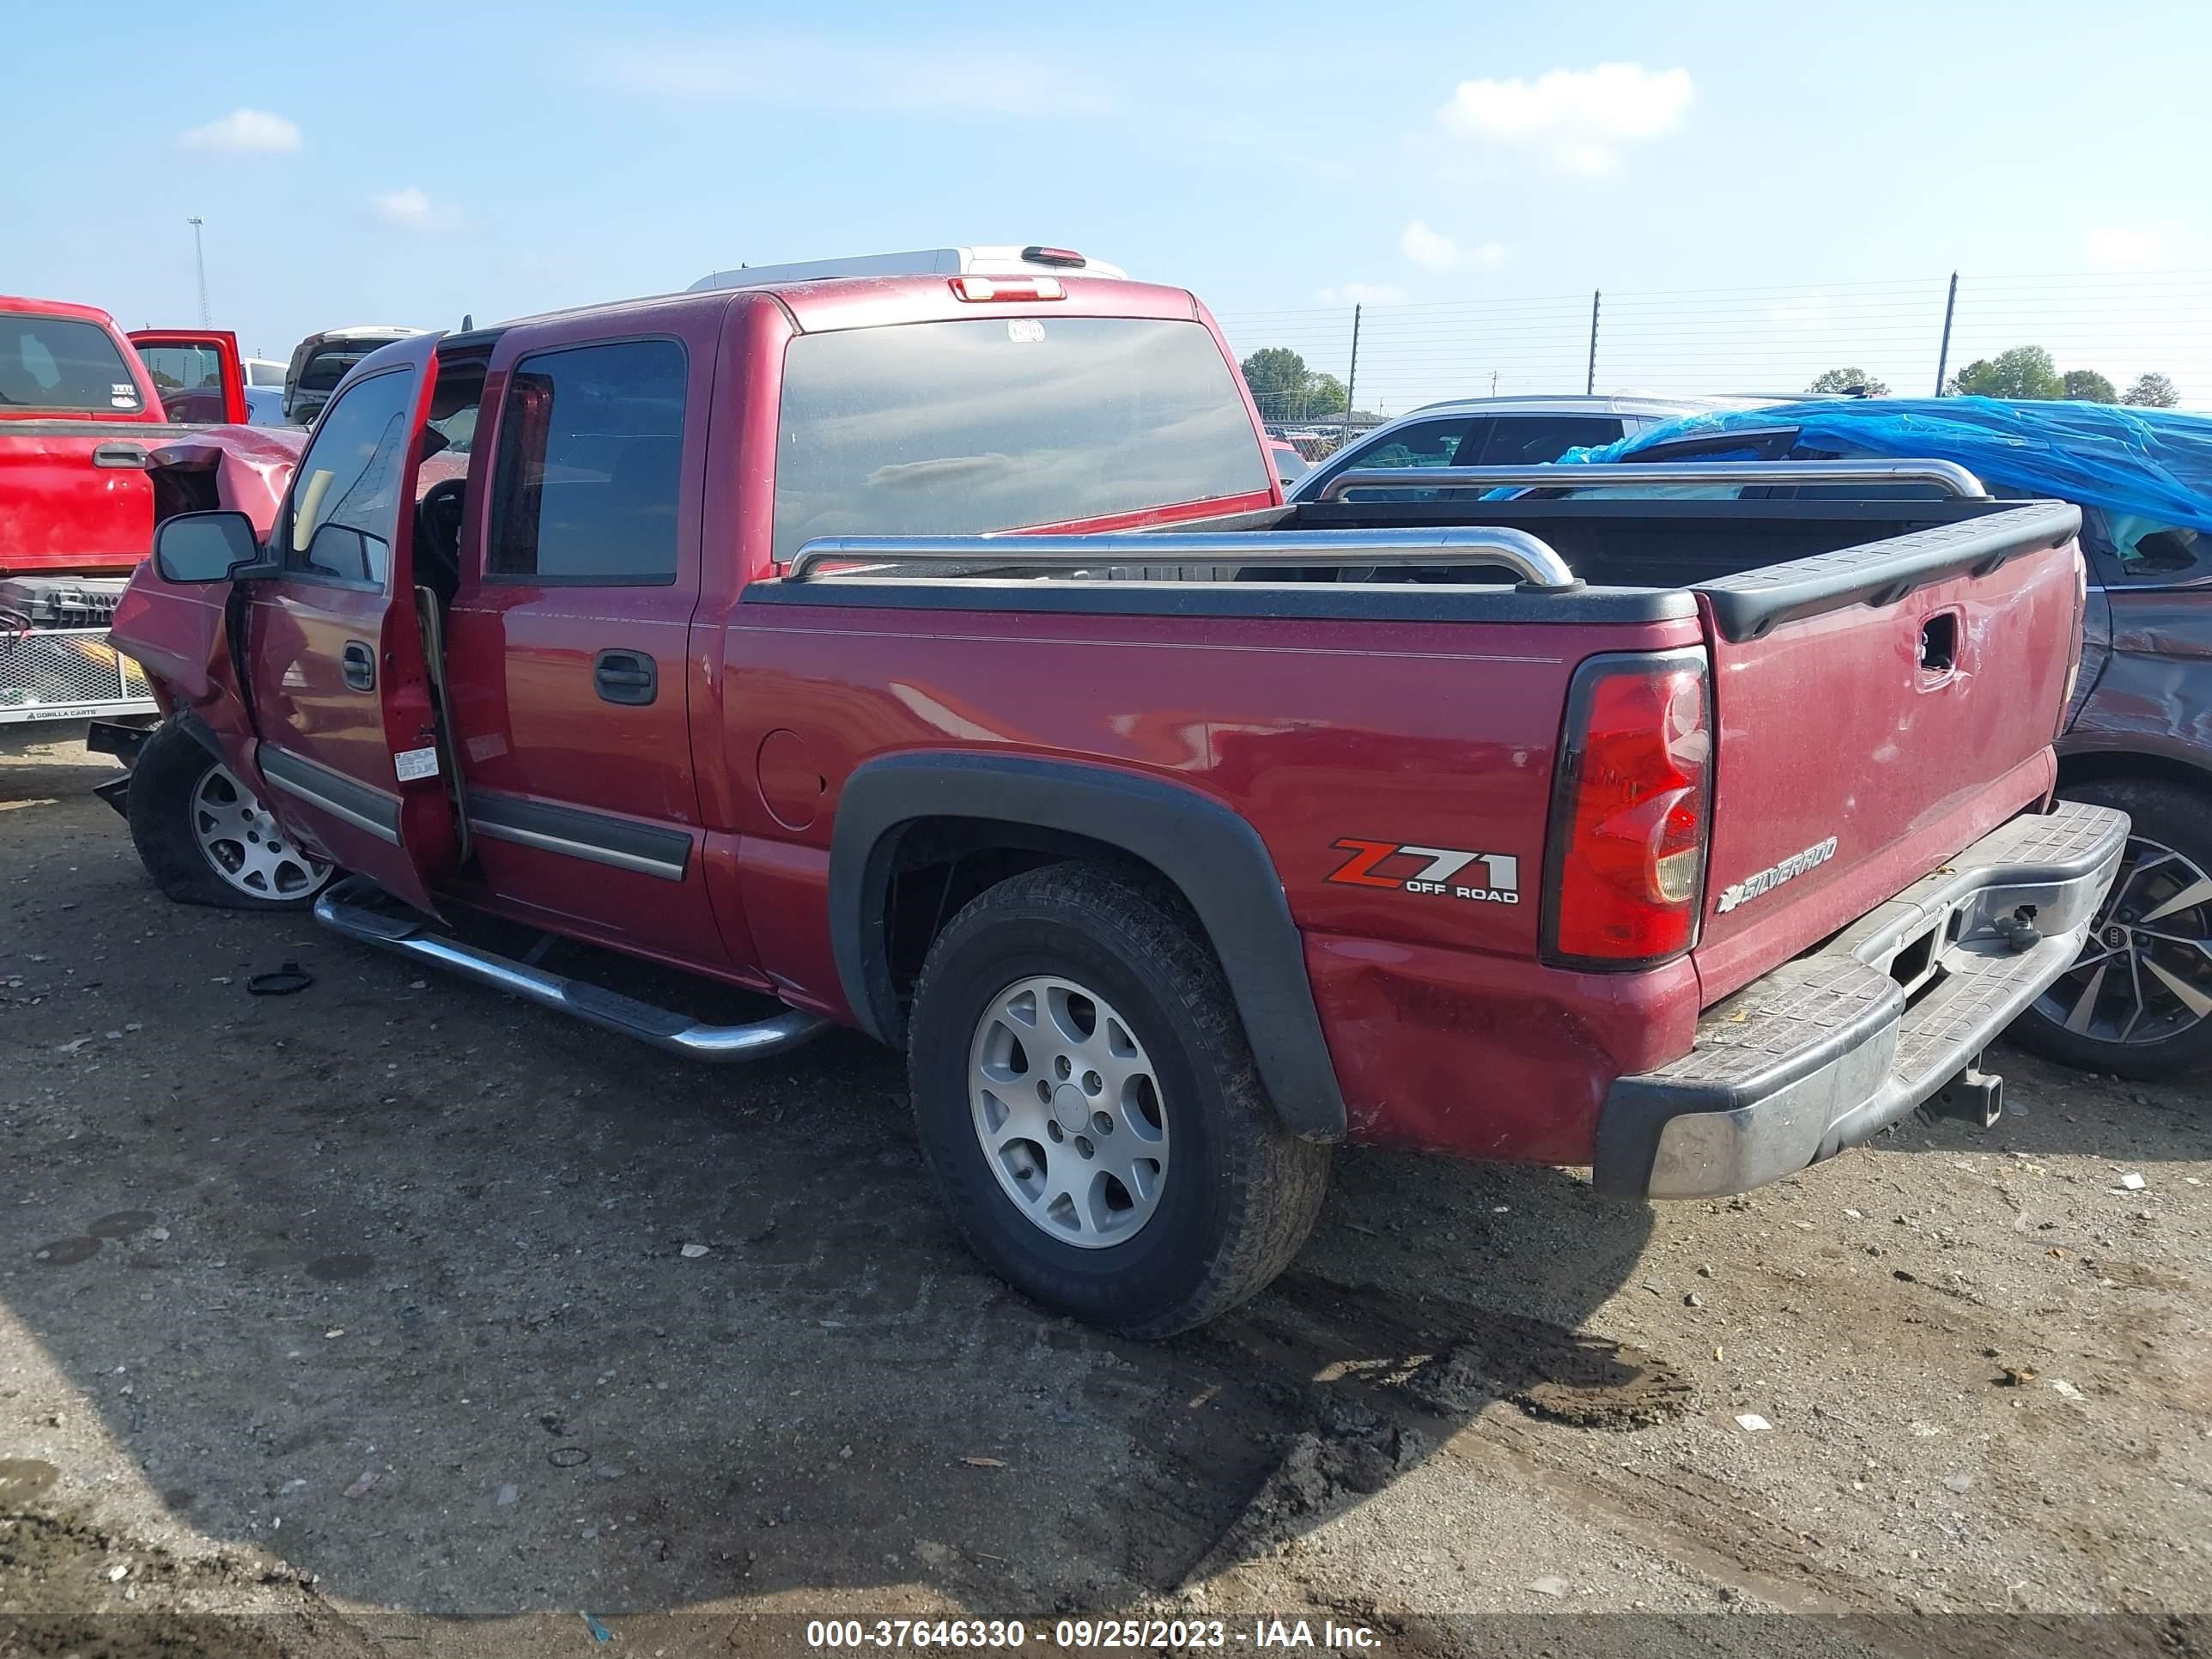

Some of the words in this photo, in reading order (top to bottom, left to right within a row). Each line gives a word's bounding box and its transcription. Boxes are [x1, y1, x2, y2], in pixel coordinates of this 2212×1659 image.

[1327, 838, 1517, 890] Z71
[1741, 836, 1838, 902] SILVERADO
[1406, 881, 1447, 896] OFF
[1456, 886, 1519, 903] ROAD
